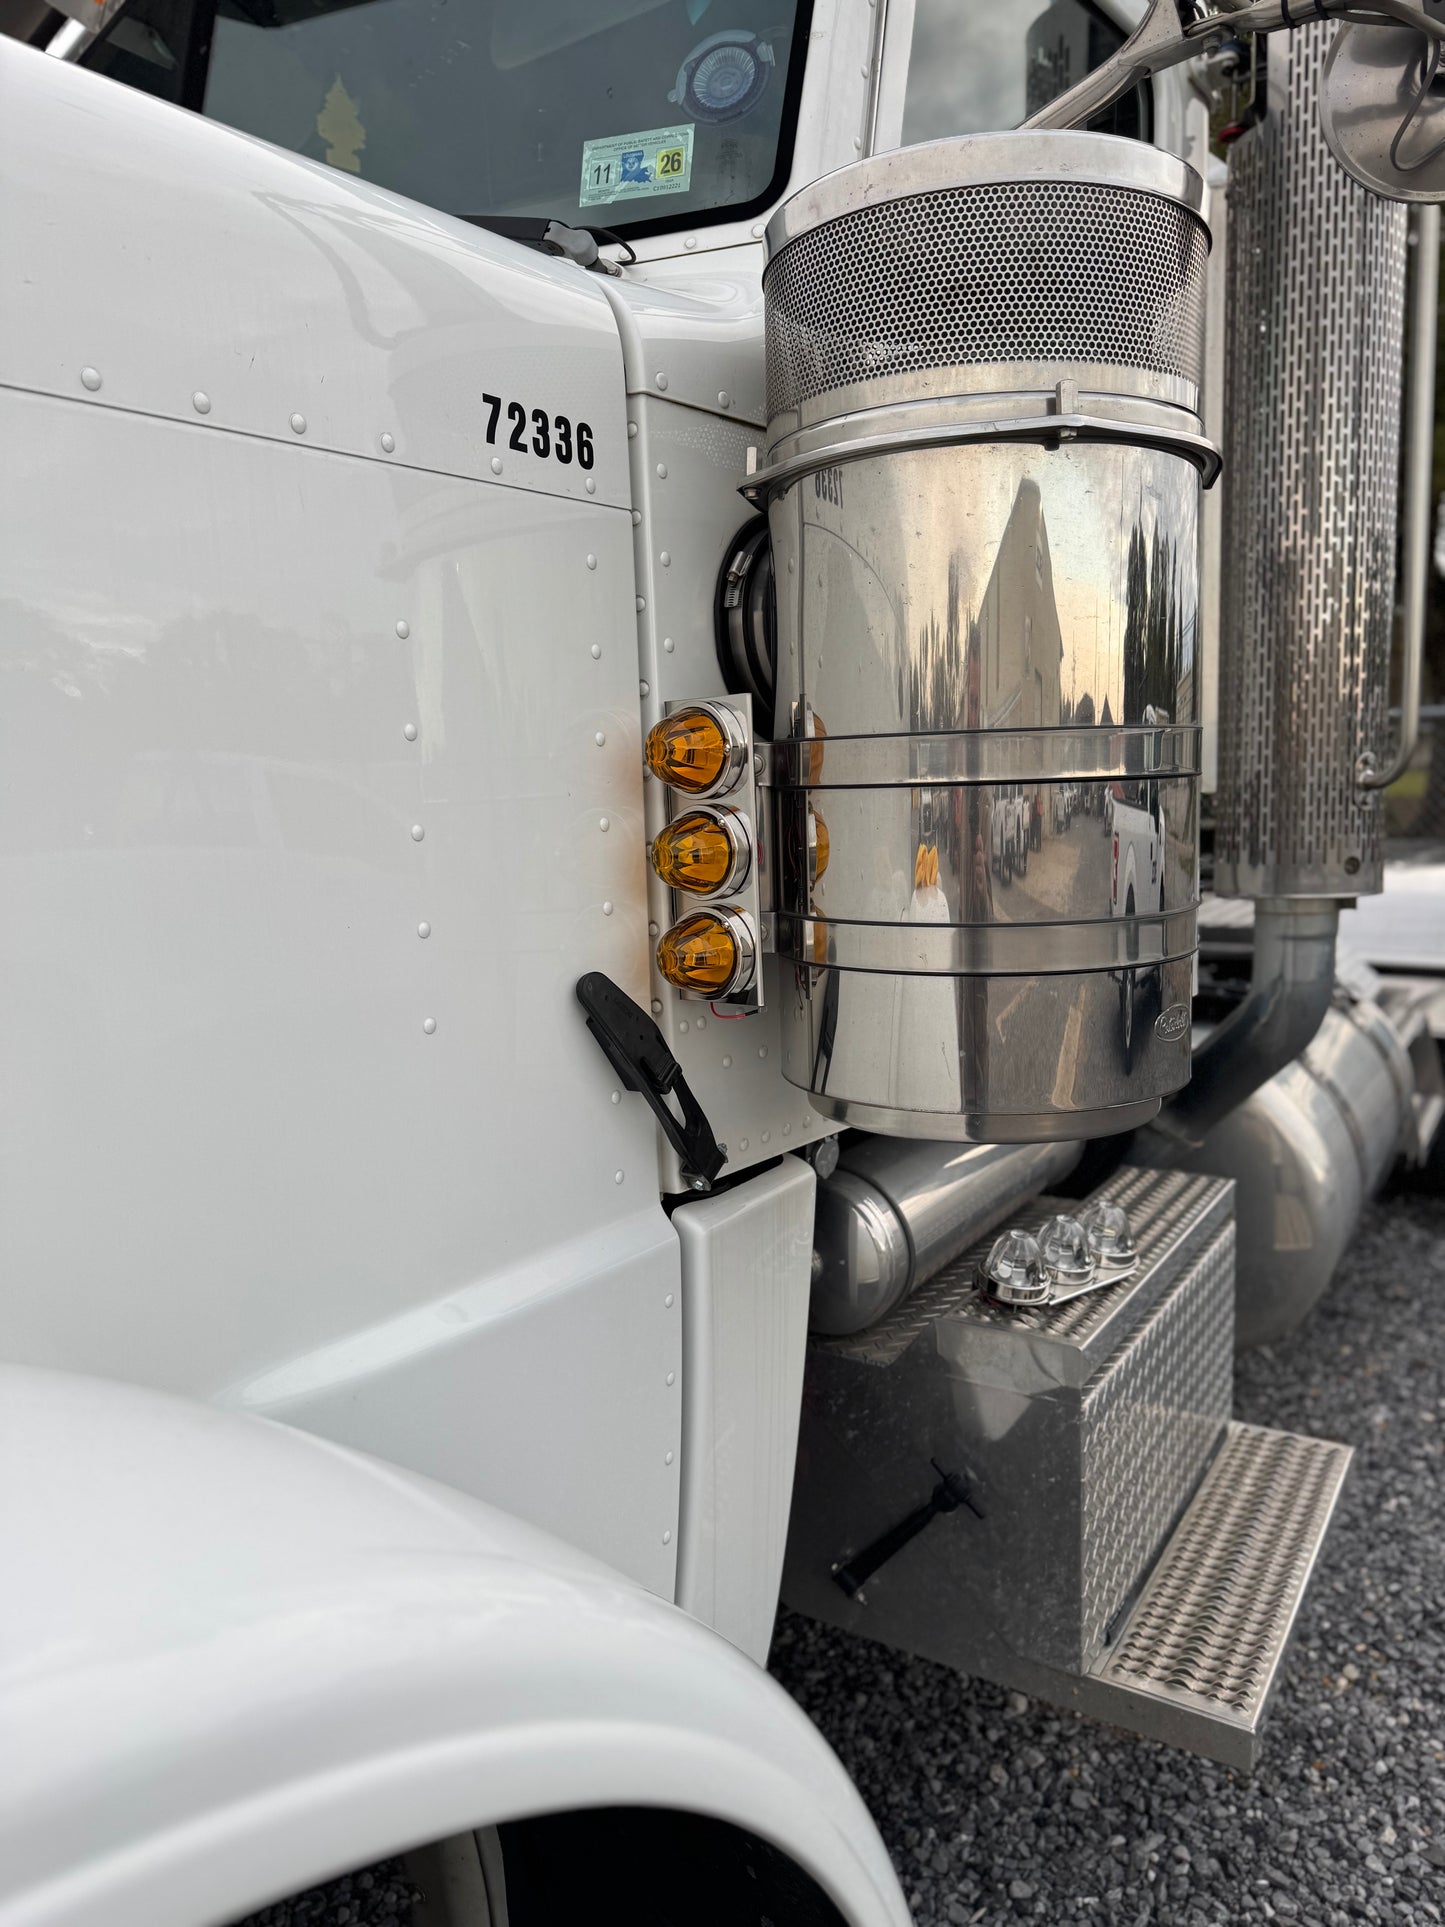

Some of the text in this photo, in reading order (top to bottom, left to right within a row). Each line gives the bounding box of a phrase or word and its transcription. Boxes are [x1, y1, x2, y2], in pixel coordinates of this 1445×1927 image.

[593, 163, 611, 185] 11
[660, 152, 681, 174] 26
[482, 393, 594, 470] 72336
